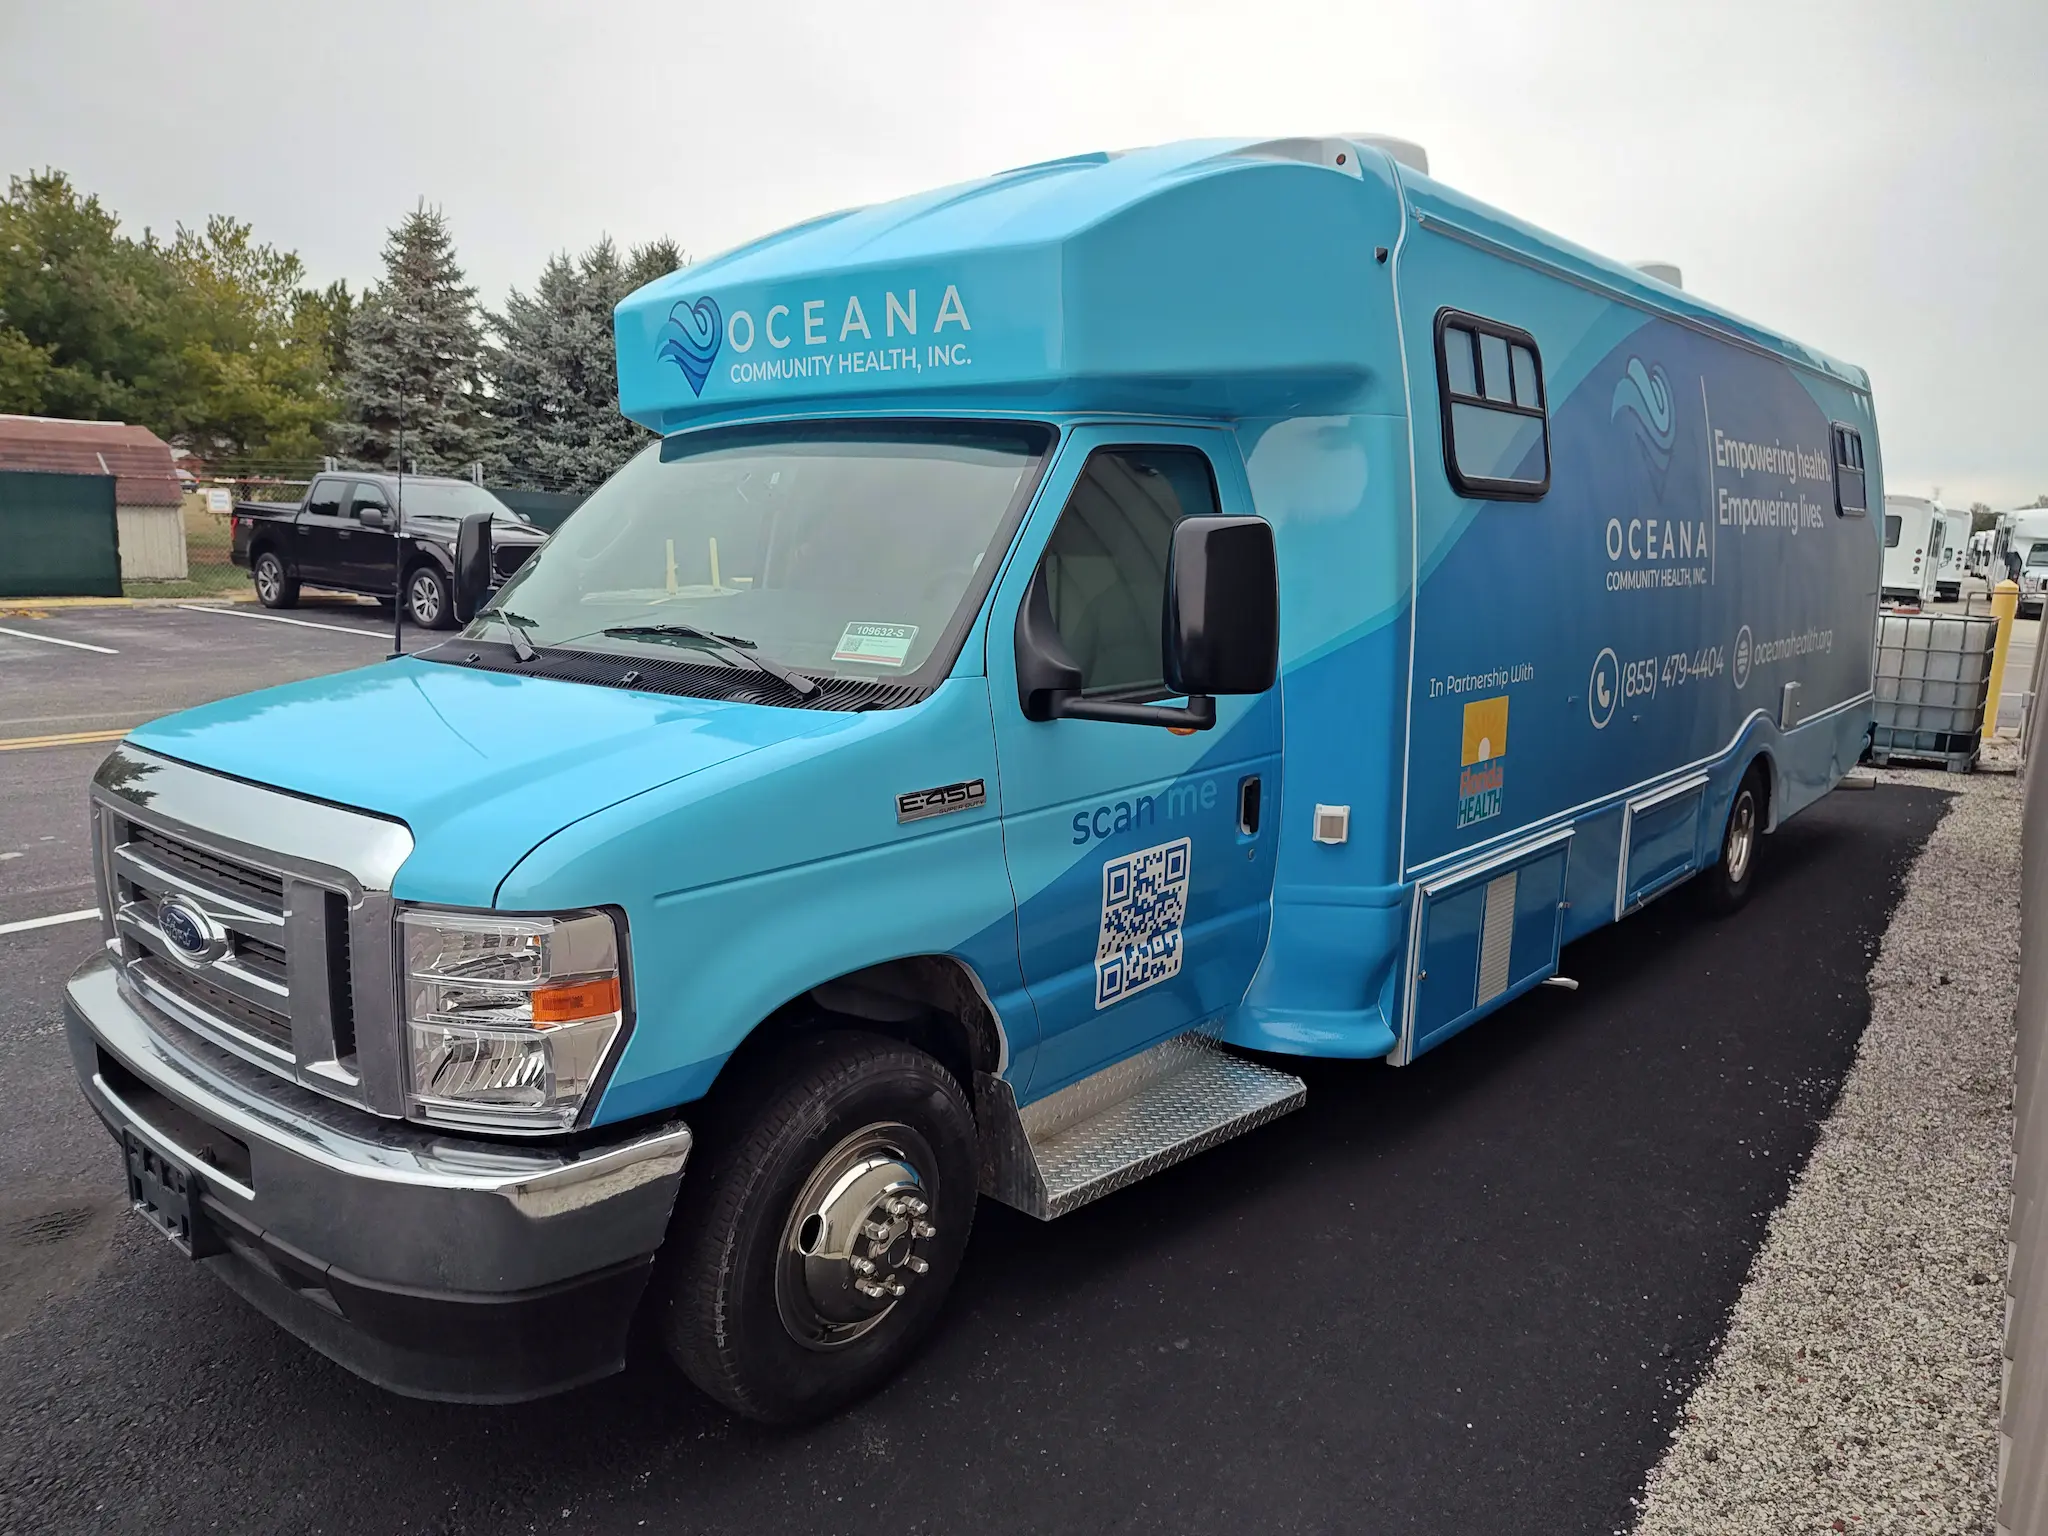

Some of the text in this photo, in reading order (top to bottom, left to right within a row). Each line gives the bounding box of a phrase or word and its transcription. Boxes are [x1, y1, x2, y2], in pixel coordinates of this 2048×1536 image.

[727, 284, 972, 354] OCEANA
[730, 343, 972, 383] COMMUNITY HEALTH, INC.
[1714, 429, 1831, 485] Empowering health.
[1718, 488, 1824, 536] Empowering lives.
[1605, 517, 1708, 561] OCEANA
[1606, 569, 1660, 591] COMMUNITY
[1660, 567, 1692, 588] HEALTH,
[856, 626, 905, 637] 109632-S
[1754, 625, 1833, 666] oceanahealth.org
[1429, 661, 1534, 698] In Partnership With
[1621, 645, 1724, 708] (855) 479-4404
[1460, 759, 1503, 798] Florida
[1072, 779, 1218, 845] scan me
[1458, 787, 1502, 826] HEALTH
[162, 912, 192, 947] Ford
